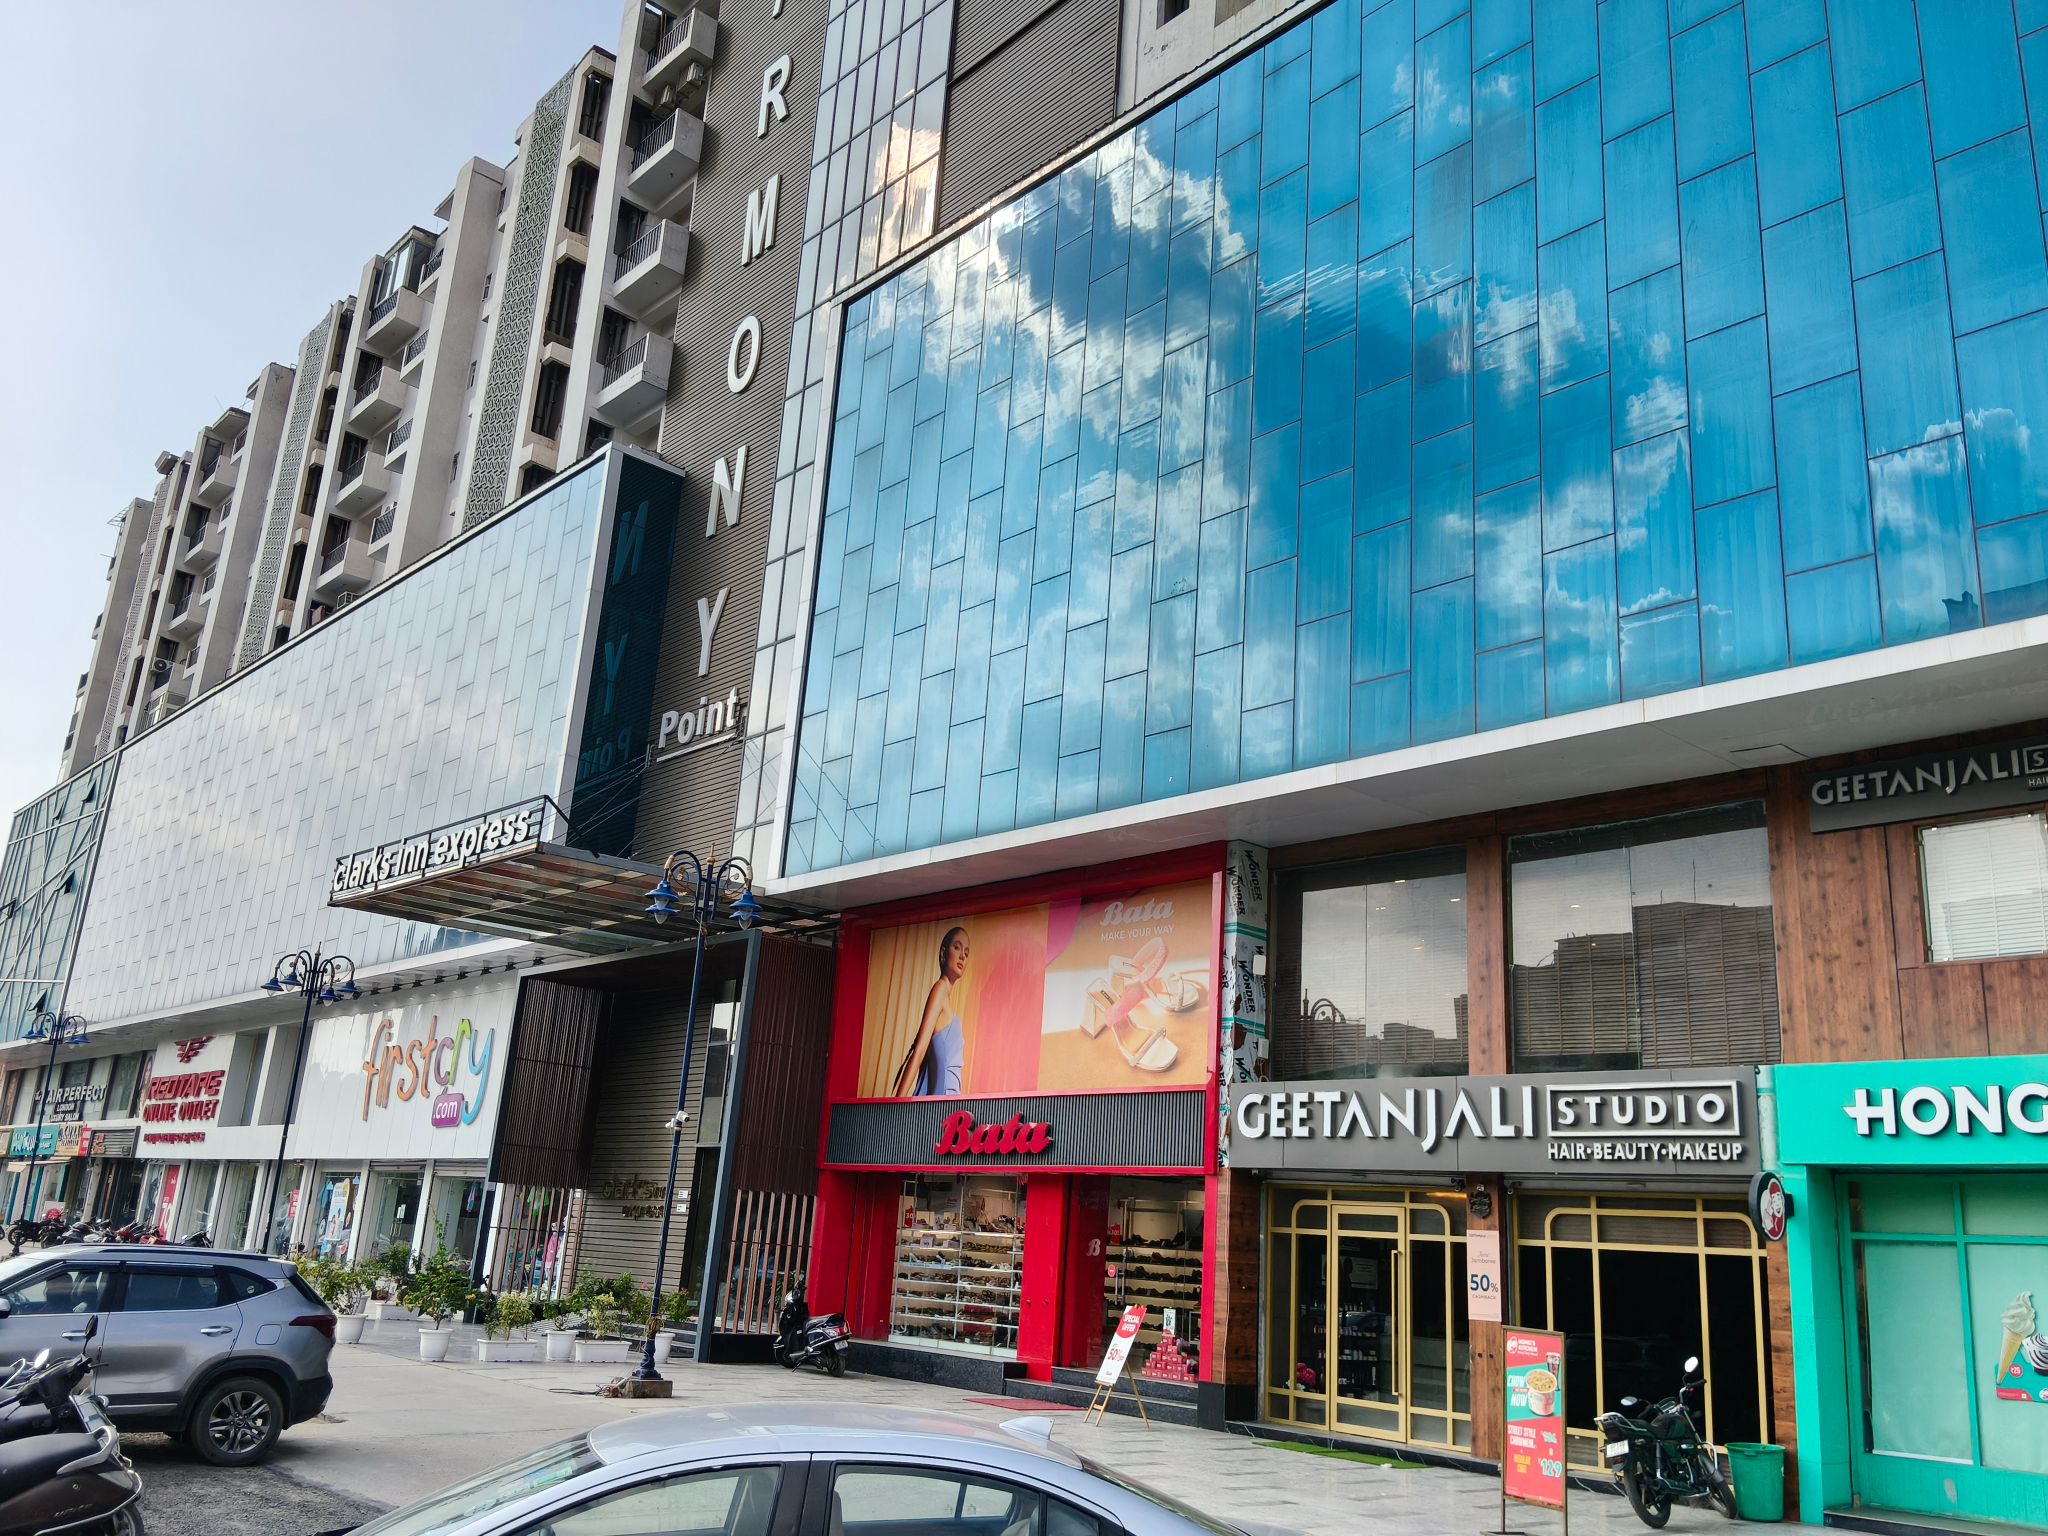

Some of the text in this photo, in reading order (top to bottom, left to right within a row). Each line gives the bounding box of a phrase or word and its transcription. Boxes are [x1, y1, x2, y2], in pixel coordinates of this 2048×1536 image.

[658, 686, 738, 749] Point
[1811, 750, 2020, 805] GEETANJALI
[2028, 776, 2048, 787] HAI
[394, 838, 429, 876] inn
[435, 810, 531, 868] express
[1100, 897, 1175, 927] Bata
[1101, 924, 1175, 942] MAKE YOUR WAY
[146, 1070, 226, 1101] REDTAPE
[362, 1015, 495, 1125] firstcry
[62, 1084, 108, 1103] PERFECT
[143, 1099, 220, 1123] ONLINE OUTLET
[1237, 1085, 1726, 1153] GEETANJALI STUDIO
[934, 1109, 1053, 1155] Bata
[1470, 1273, 1499, 1293] 50%
